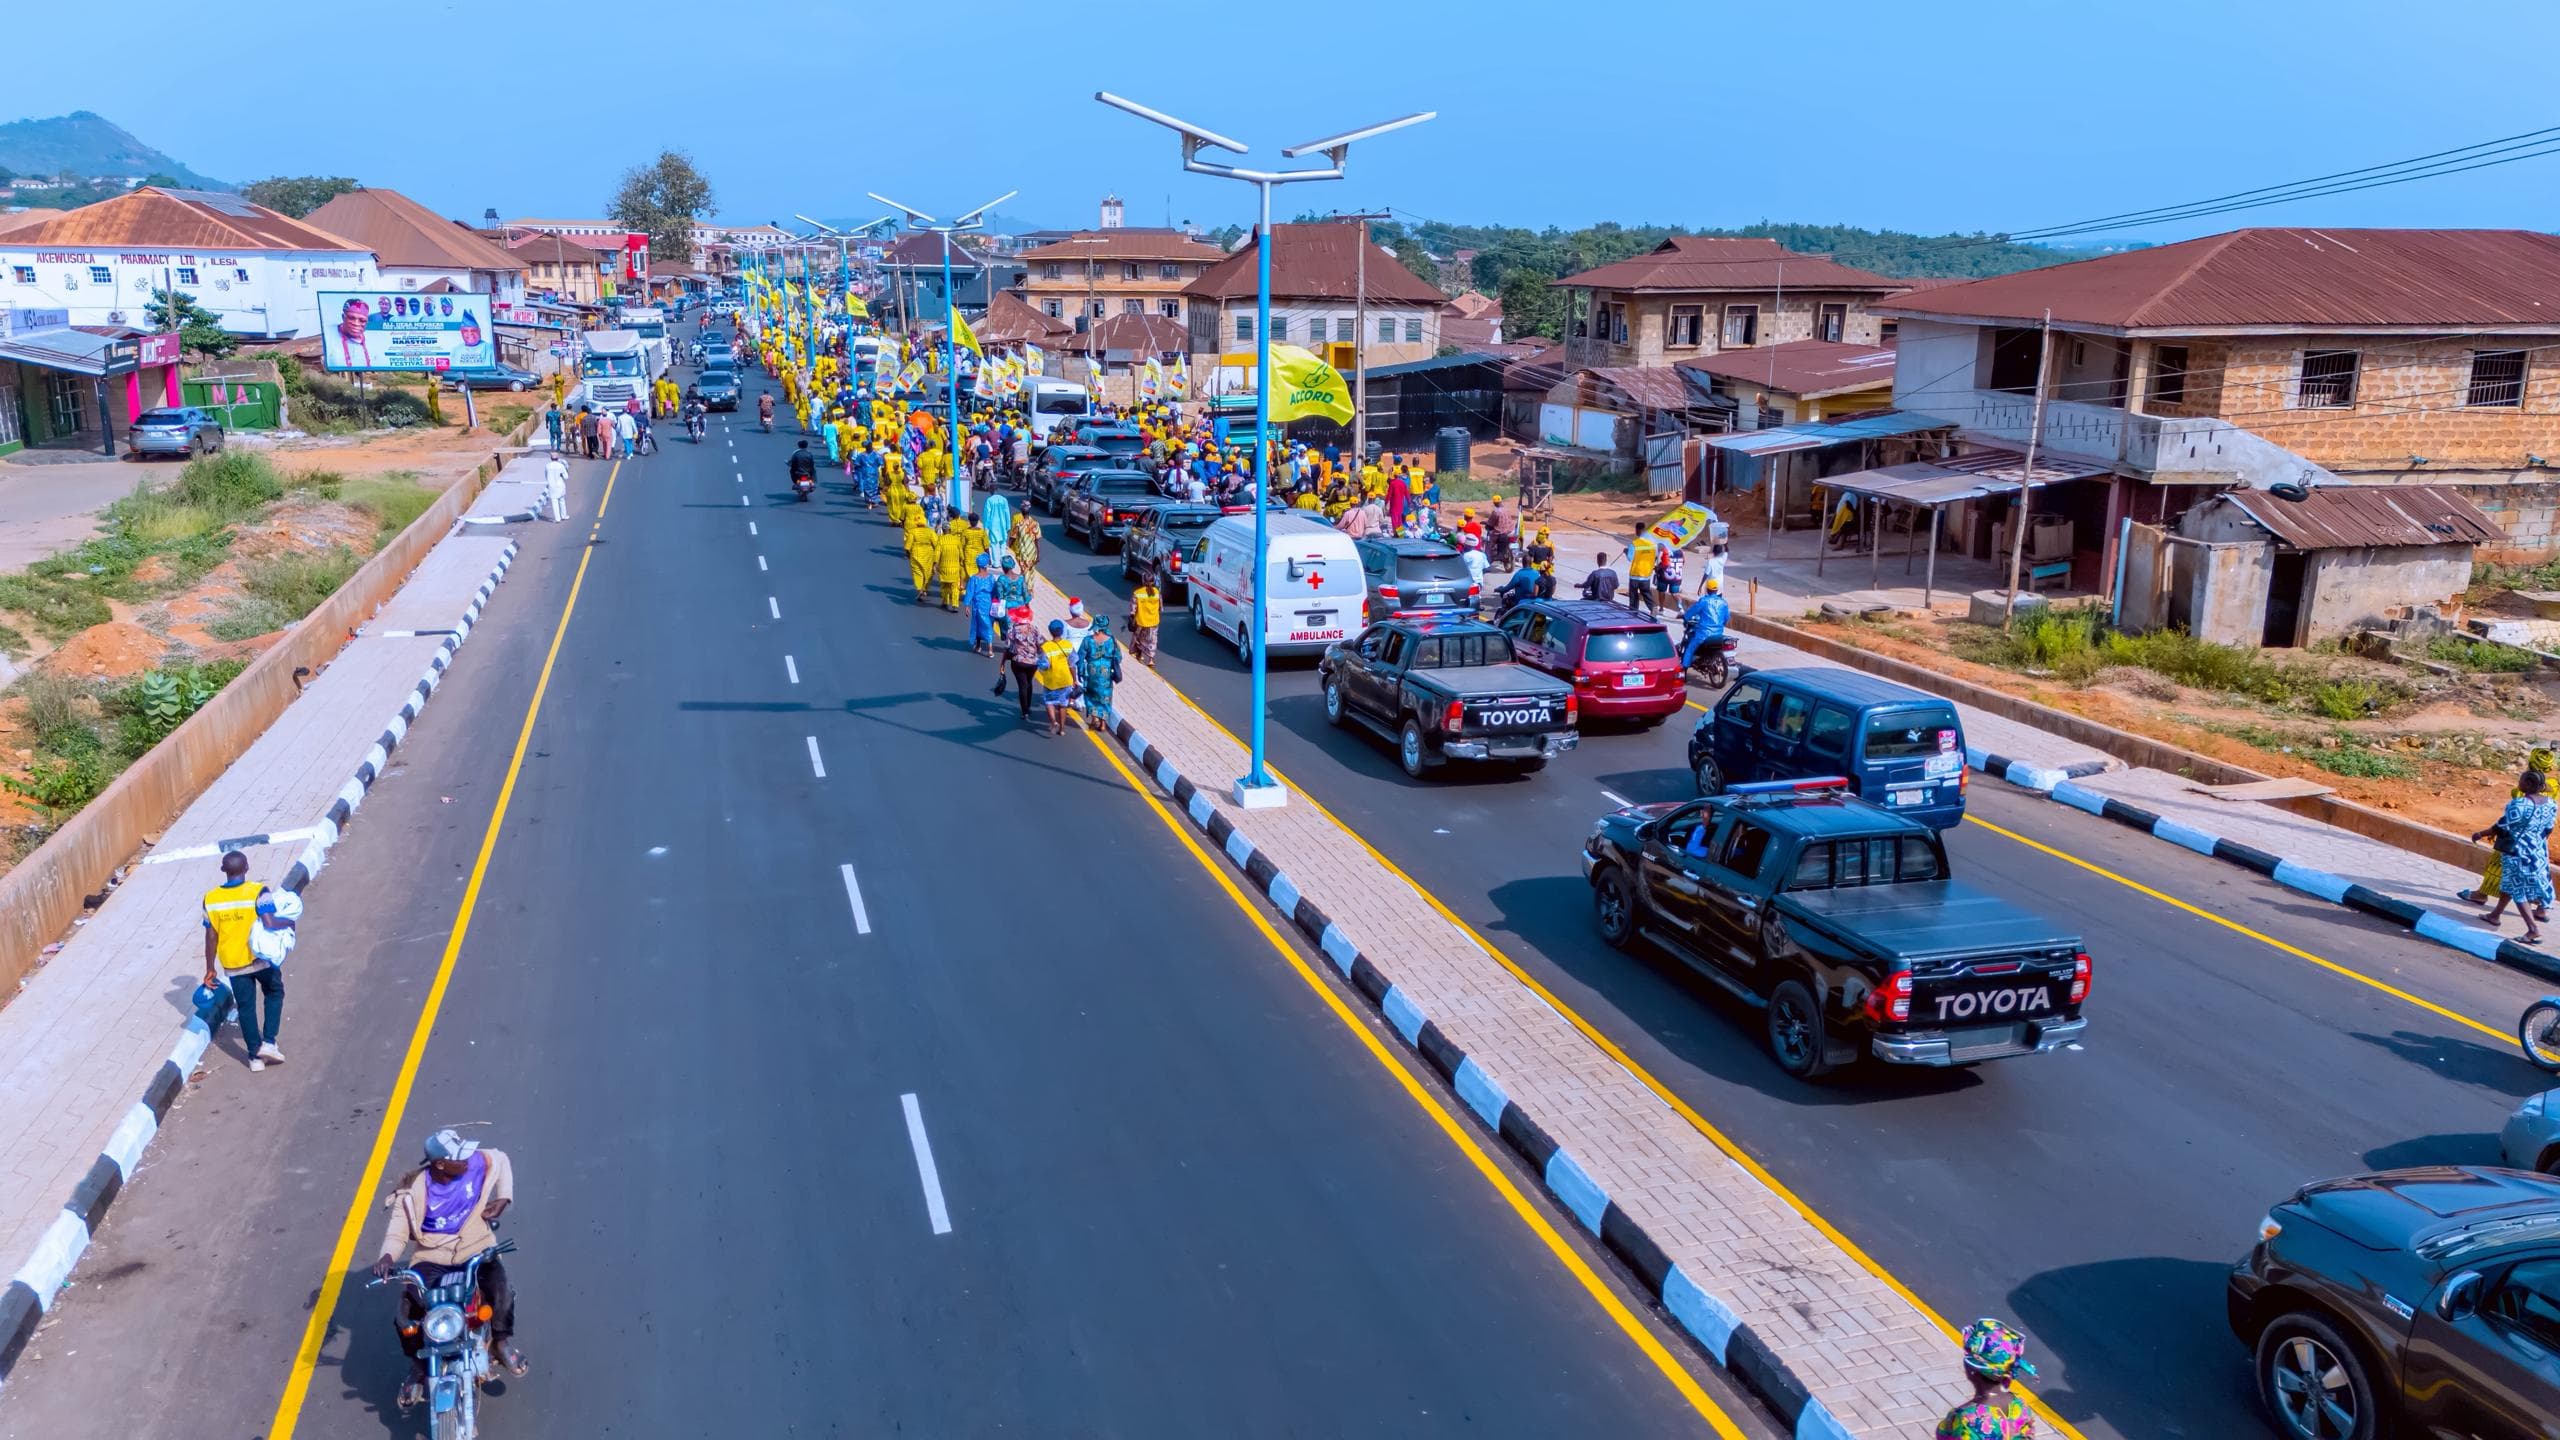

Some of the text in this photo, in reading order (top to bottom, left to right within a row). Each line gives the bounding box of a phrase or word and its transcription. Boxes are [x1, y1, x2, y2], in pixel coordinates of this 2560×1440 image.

[36, 252, 96, 265] AKEWUSOLA
[120, 253, 170, 265] PHARMACY
[210, 258, 238, 266] ILESA
[1289, 389, 1335, 405] ACCORD
[1290, 630, 1344, 641] AMBULANCE
[1479, 708, 1551, 726] TOYOTA
[1935, 986, 2051, 1020] TOYOTA
